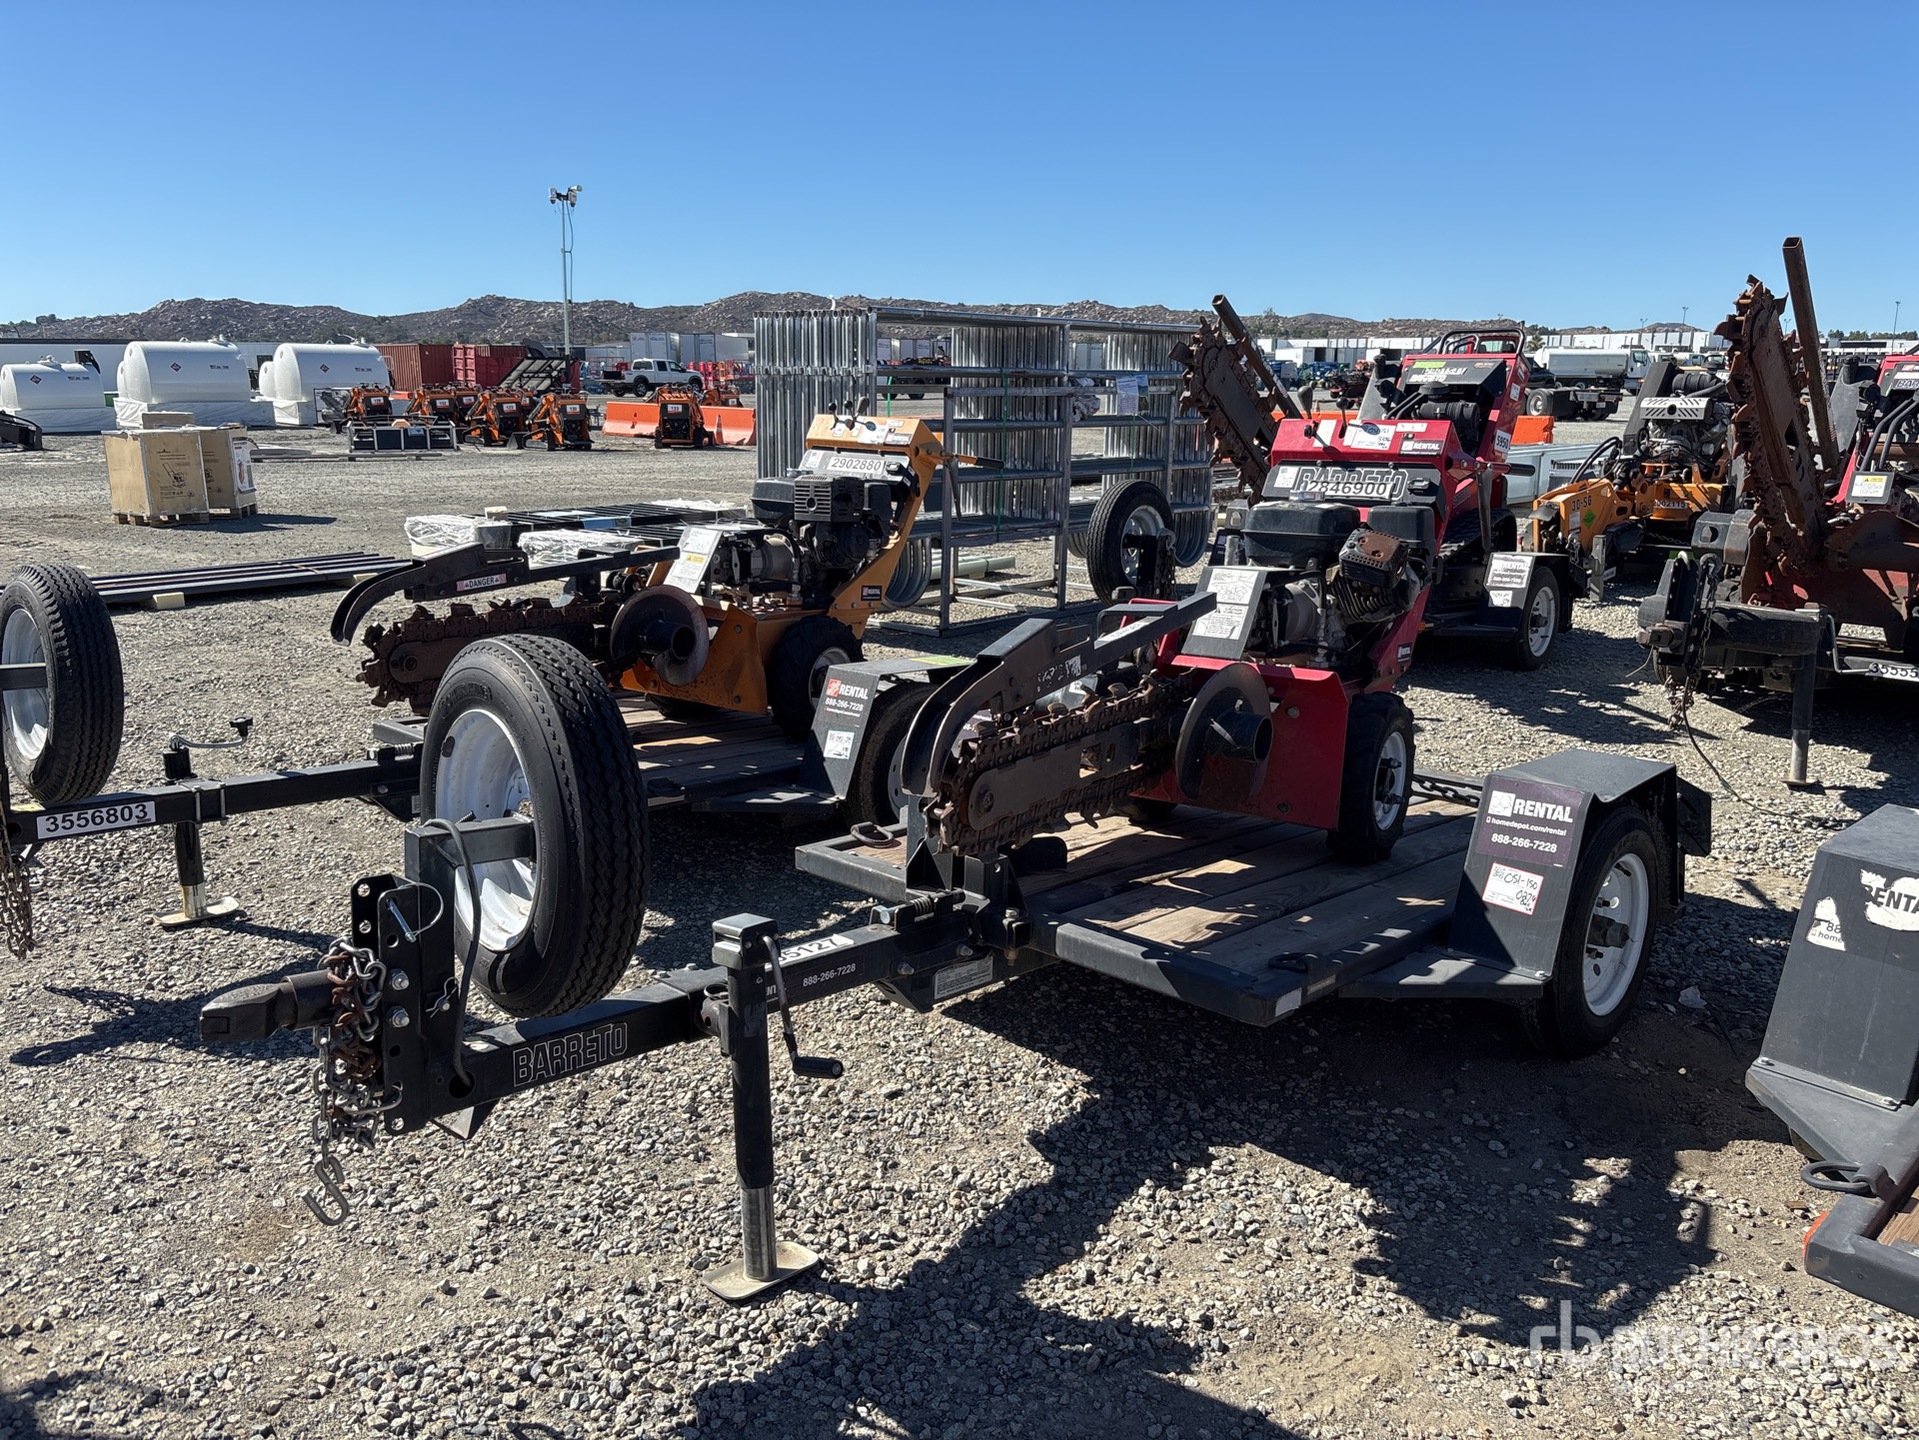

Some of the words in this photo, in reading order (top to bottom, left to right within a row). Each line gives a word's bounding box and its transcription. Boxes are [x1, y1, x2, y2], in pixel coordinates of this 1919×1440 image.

[831, 458, 882, 472] 2902880
[1309, 480, 1387, 495] 2846900
[469, 576, 495, 588] DANGER
[839, 683, 869, 700] RENTAL
[45, 803, 148, 833] 3556803
[1512, 798, 1574, 823] RENTAL
[1491, 817, 1567, 836] homedepot.com/rental
[1491, 833, 1558, 853] 888-266-7228
[802, 963, 856, 987] 888-266-7228
[512, 1022, 628, 1087] BARRETO
